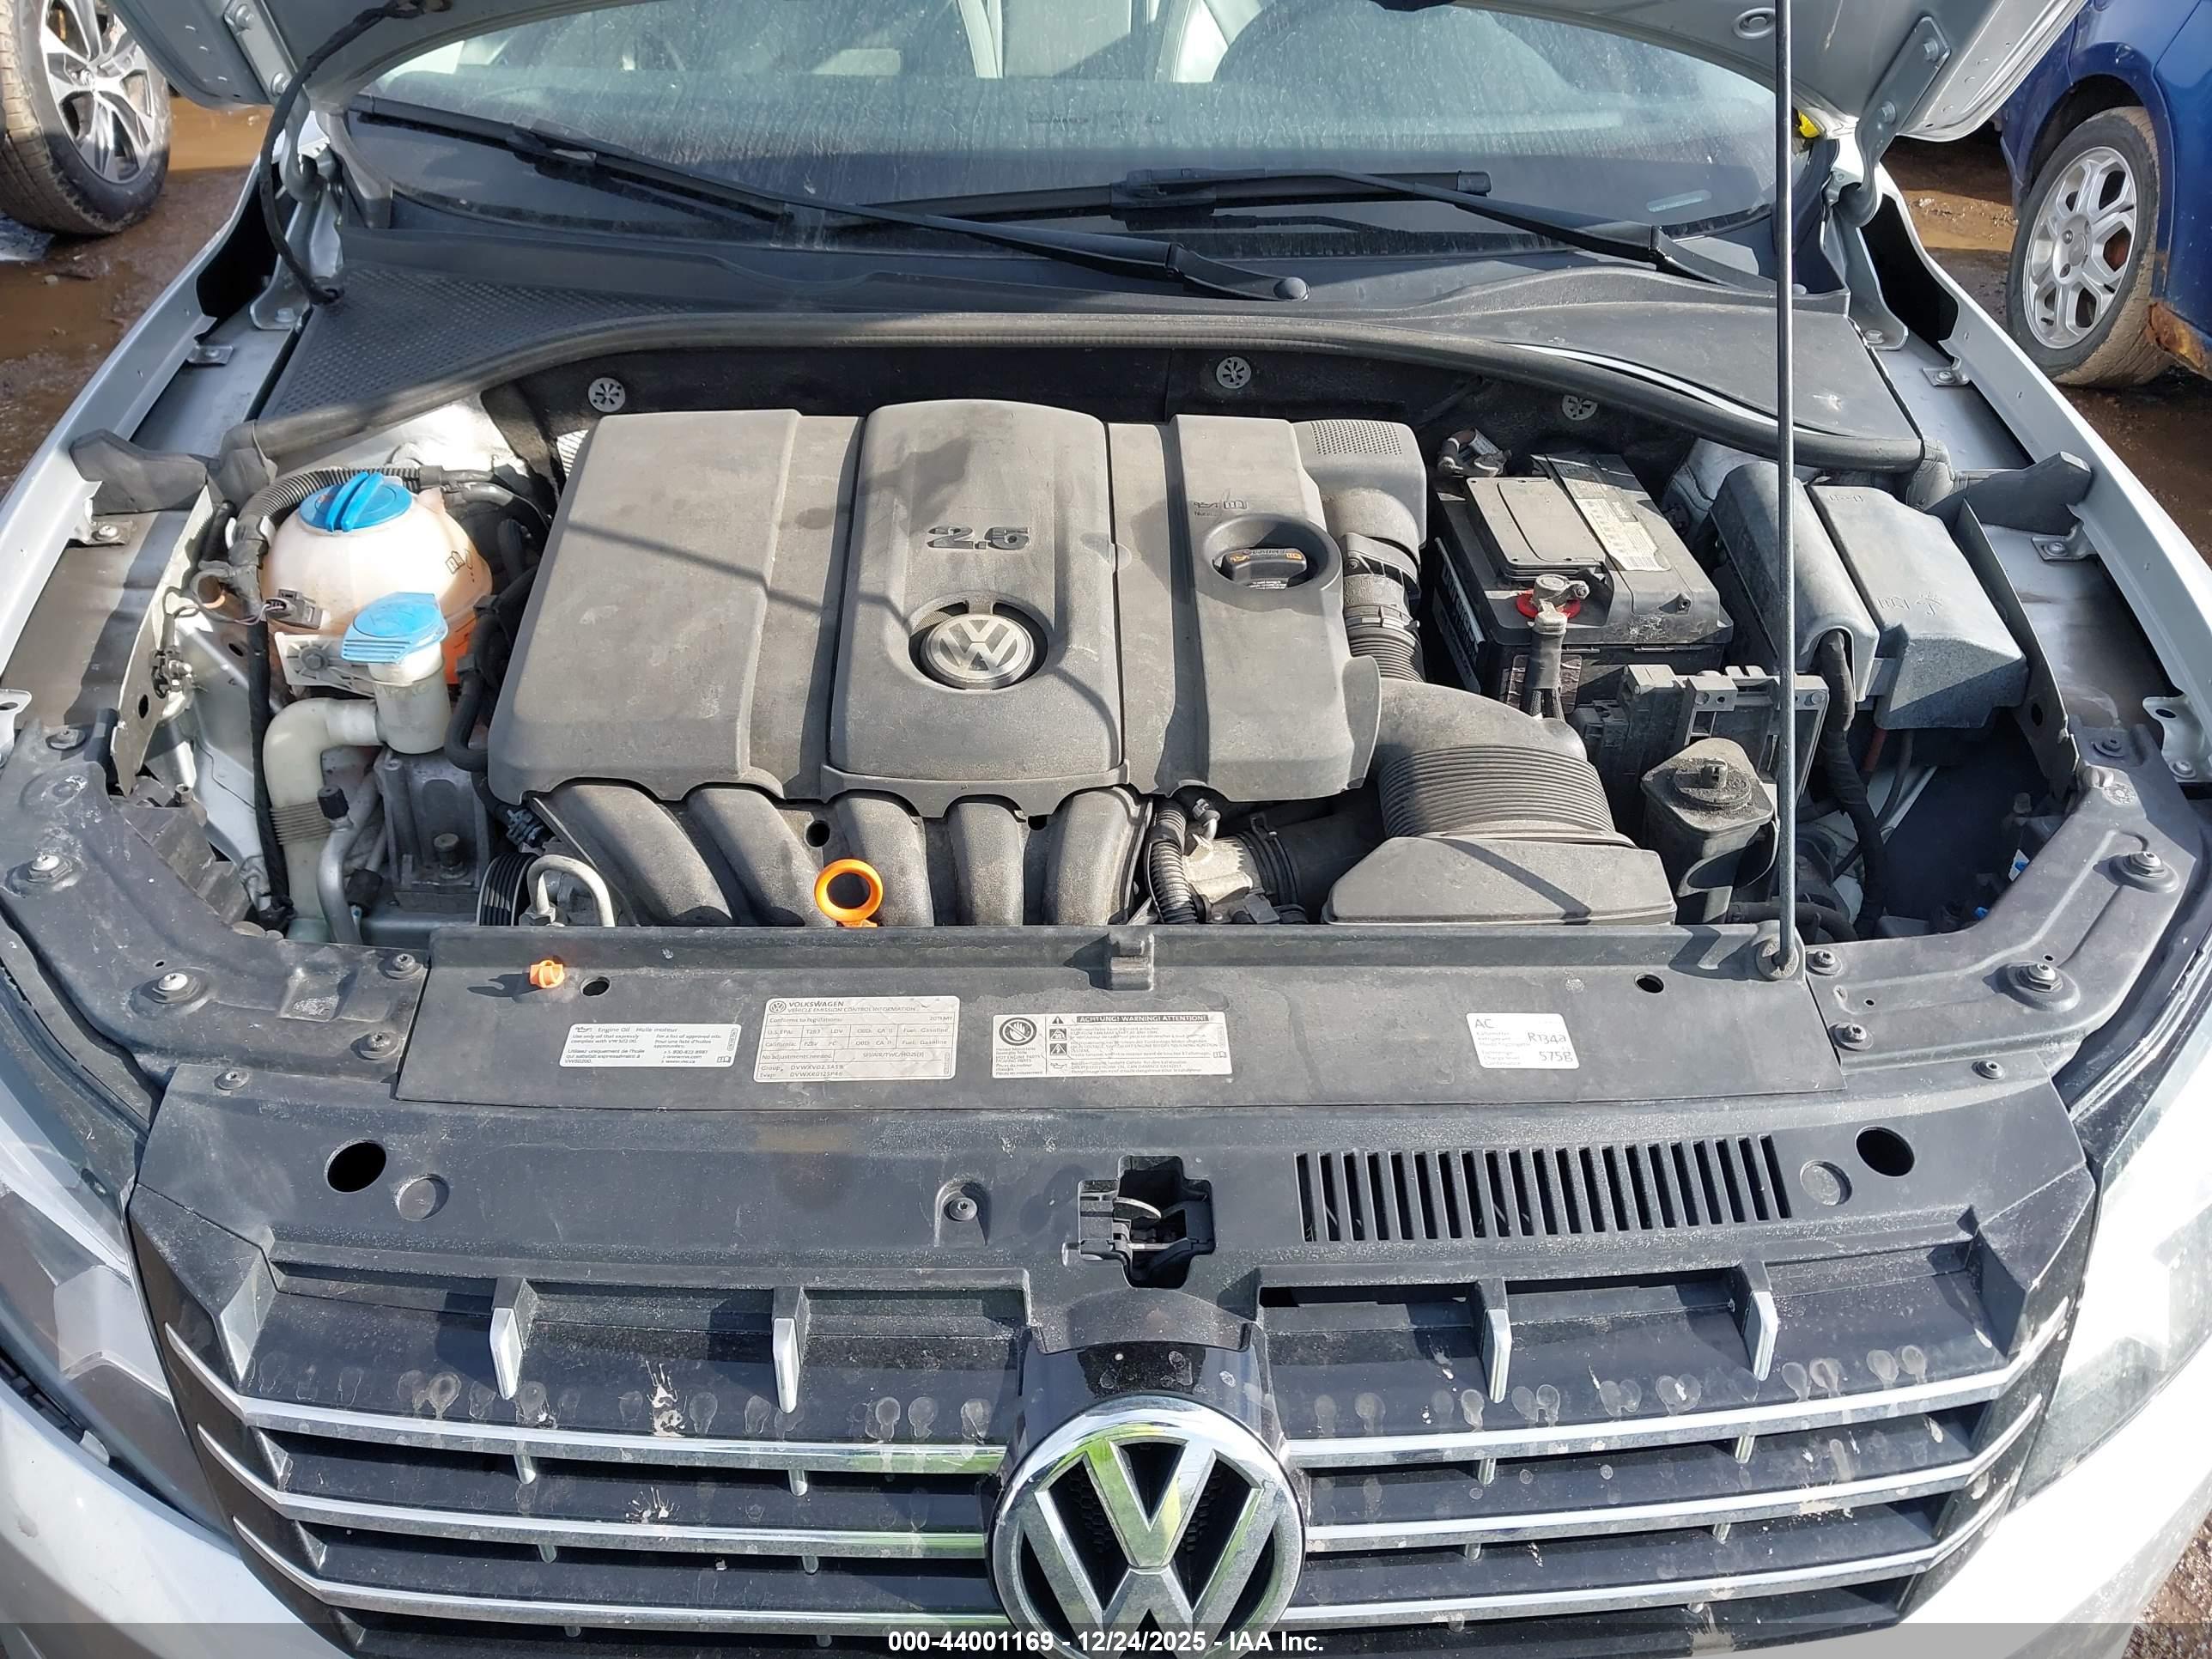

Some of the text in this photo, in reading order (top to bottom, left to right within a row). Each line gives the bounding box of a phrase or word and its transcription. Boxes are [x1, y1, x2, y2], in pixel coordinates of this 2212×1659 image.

[927, 526, 1030, 550] 2.5
[1474, 1018, 1495, 1029] AC
[1528, 1031, 1566, 1044] R134a
